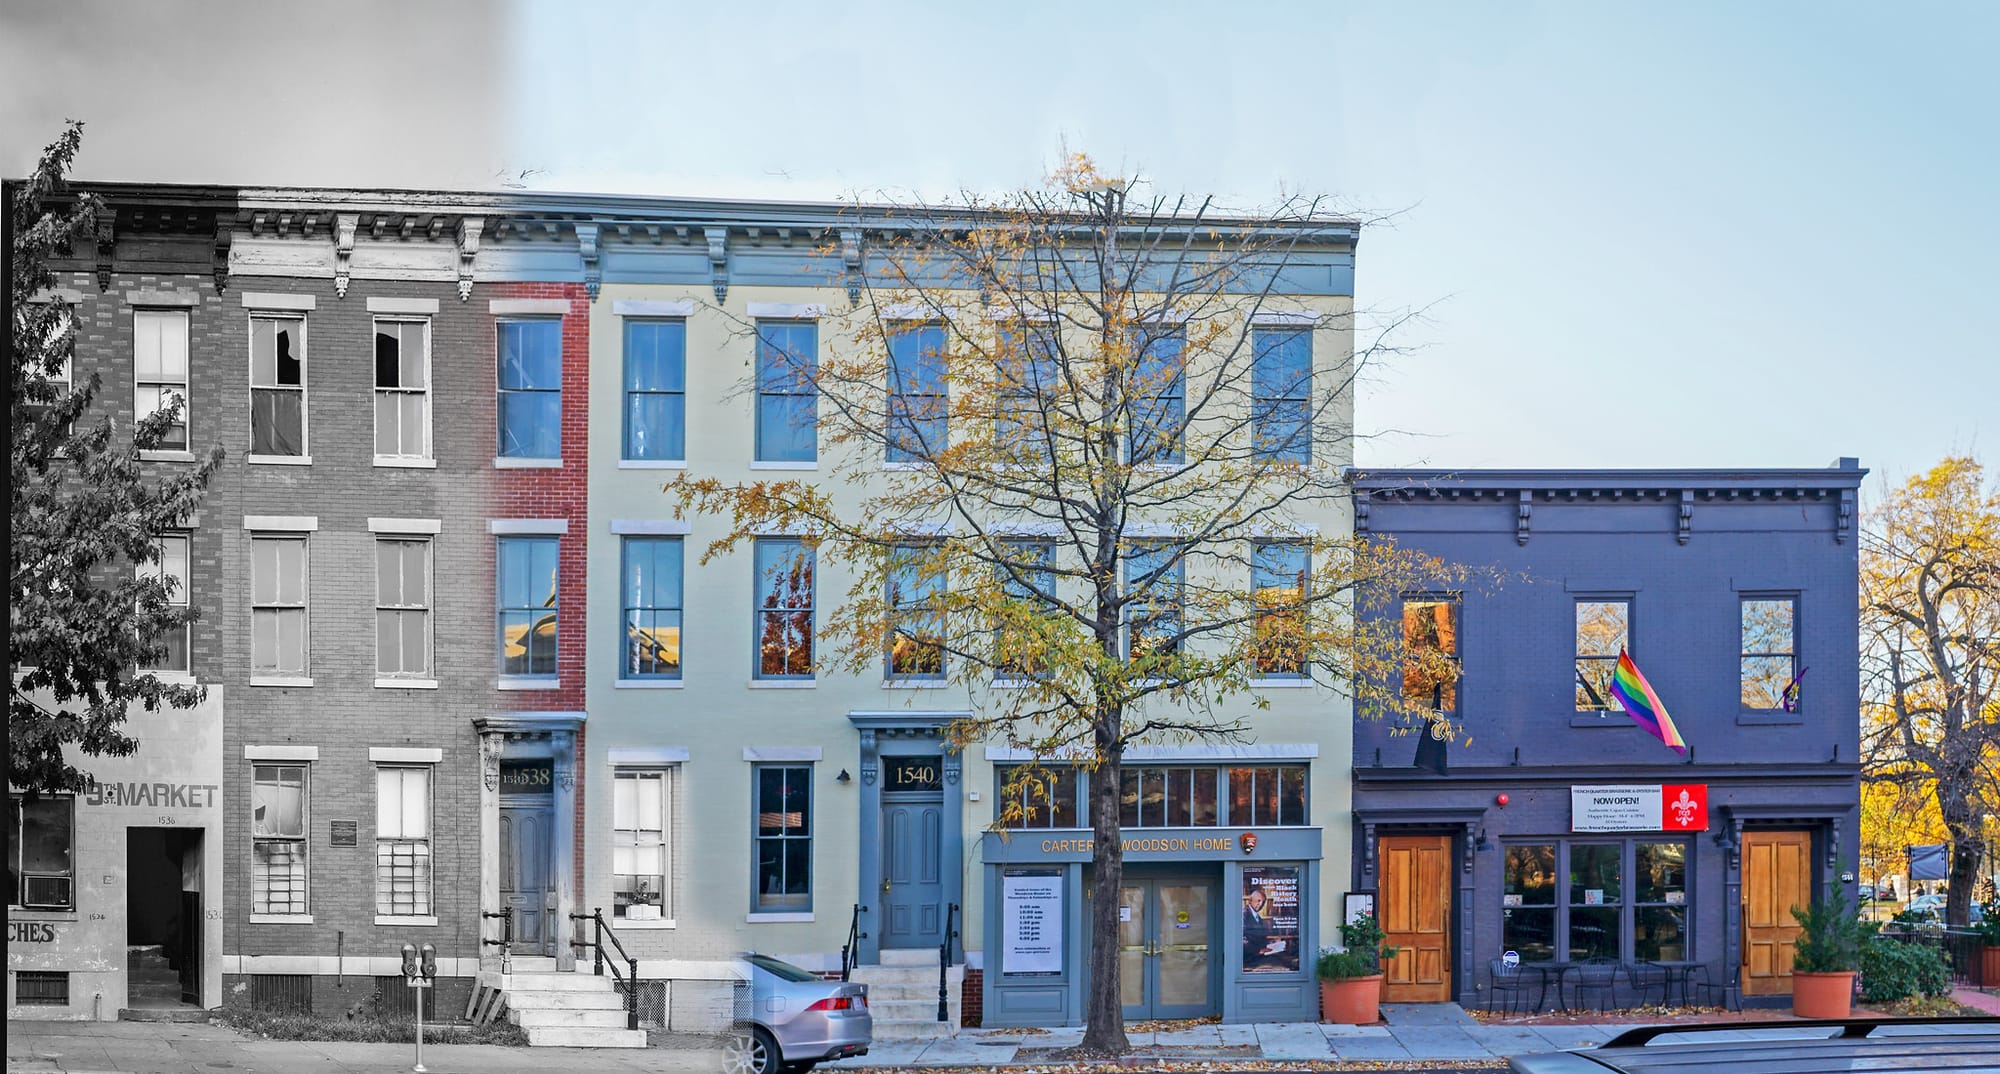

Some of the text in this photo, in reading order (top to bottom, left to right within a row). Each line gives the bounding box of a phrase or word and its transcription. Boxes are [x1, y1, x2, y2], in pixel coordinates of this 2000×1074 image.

[896, 766, 934, 783] 1540
[116, 782, 218, 808] MARKET
[1593, 797, 1640, 805] NOW OPEN!
[158, 816, 176, 825] 1536
[1041, 838, 1232, 852] CARTER WOODSON HOME
[1251, 877, 1297, 885] Discover
[8, 922, 54, 944] CHES
